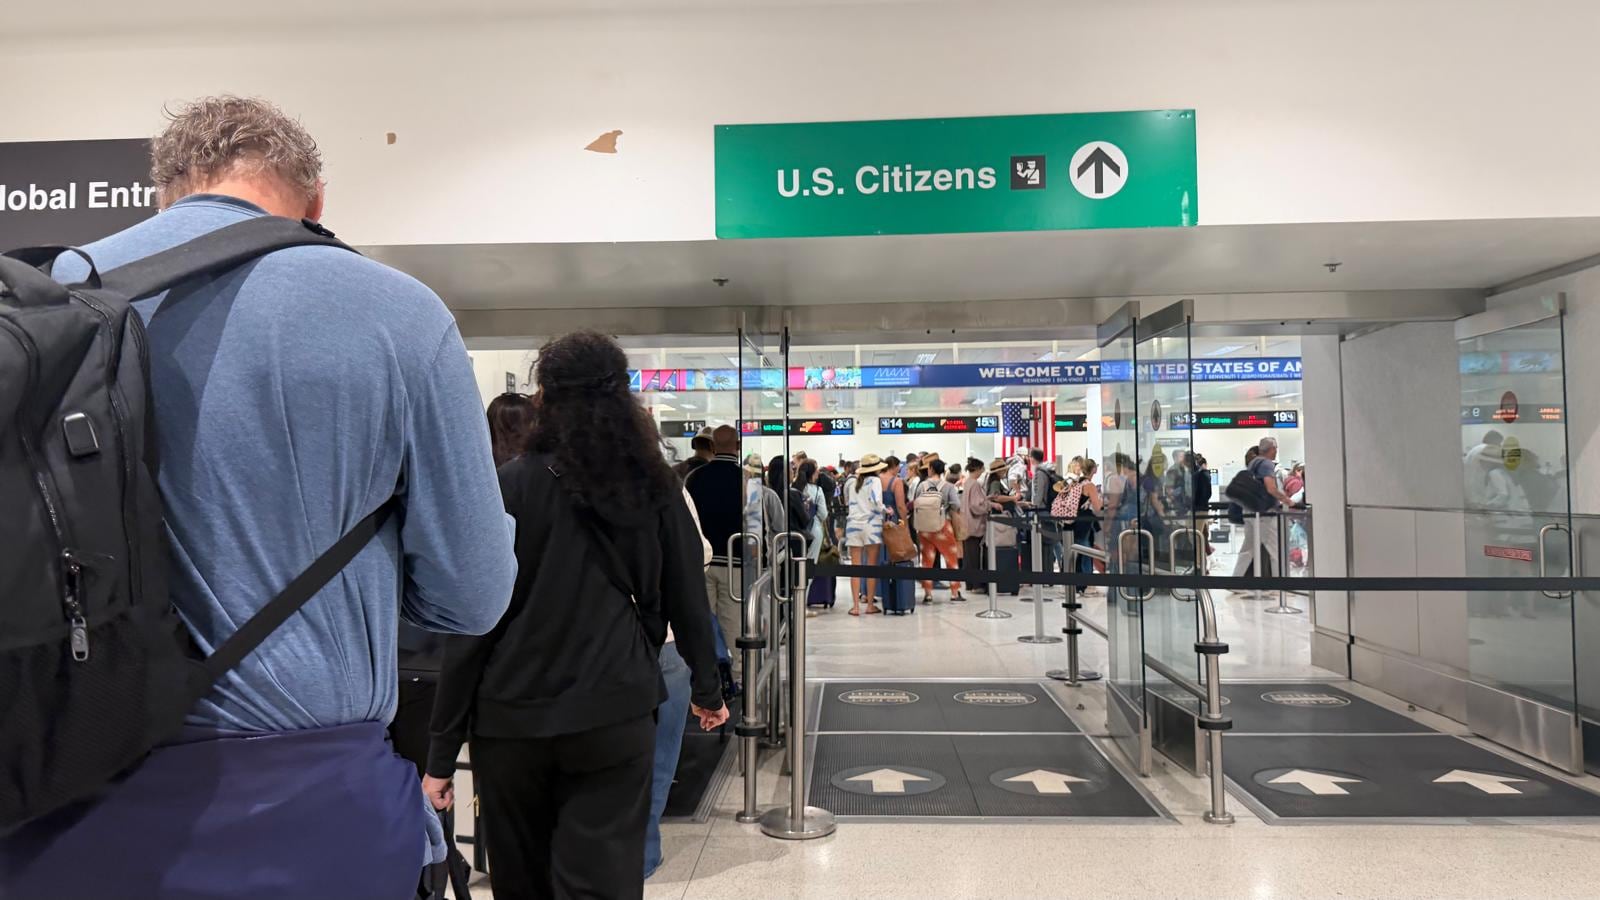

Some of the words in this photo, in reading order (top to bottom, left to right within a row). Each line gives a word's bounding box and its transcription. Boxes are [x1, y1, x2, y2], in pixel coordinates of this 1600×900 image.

[776, 167, 844, 197] U.S.
[855, 163, 997, 193] Citizens
[0, 182, 76, 211] lobal
[88, 181, 161, 212] Entr
[978, 366, 1061, 379] WELCOME
[1064, 365, 1086, 377] TO
[1089, 364, 1121, 376] TE
[1129, 363, 1188, 375] NITED
[1192, 362, 1255, 374] STATES
[1258, 362, 1281, 373] OF
[1273, 411, 1287, 421] 19
[683, 422, 695, 431] 11
[830, 419, 843, 429] 13
[890, 418, 903, 429] 14
